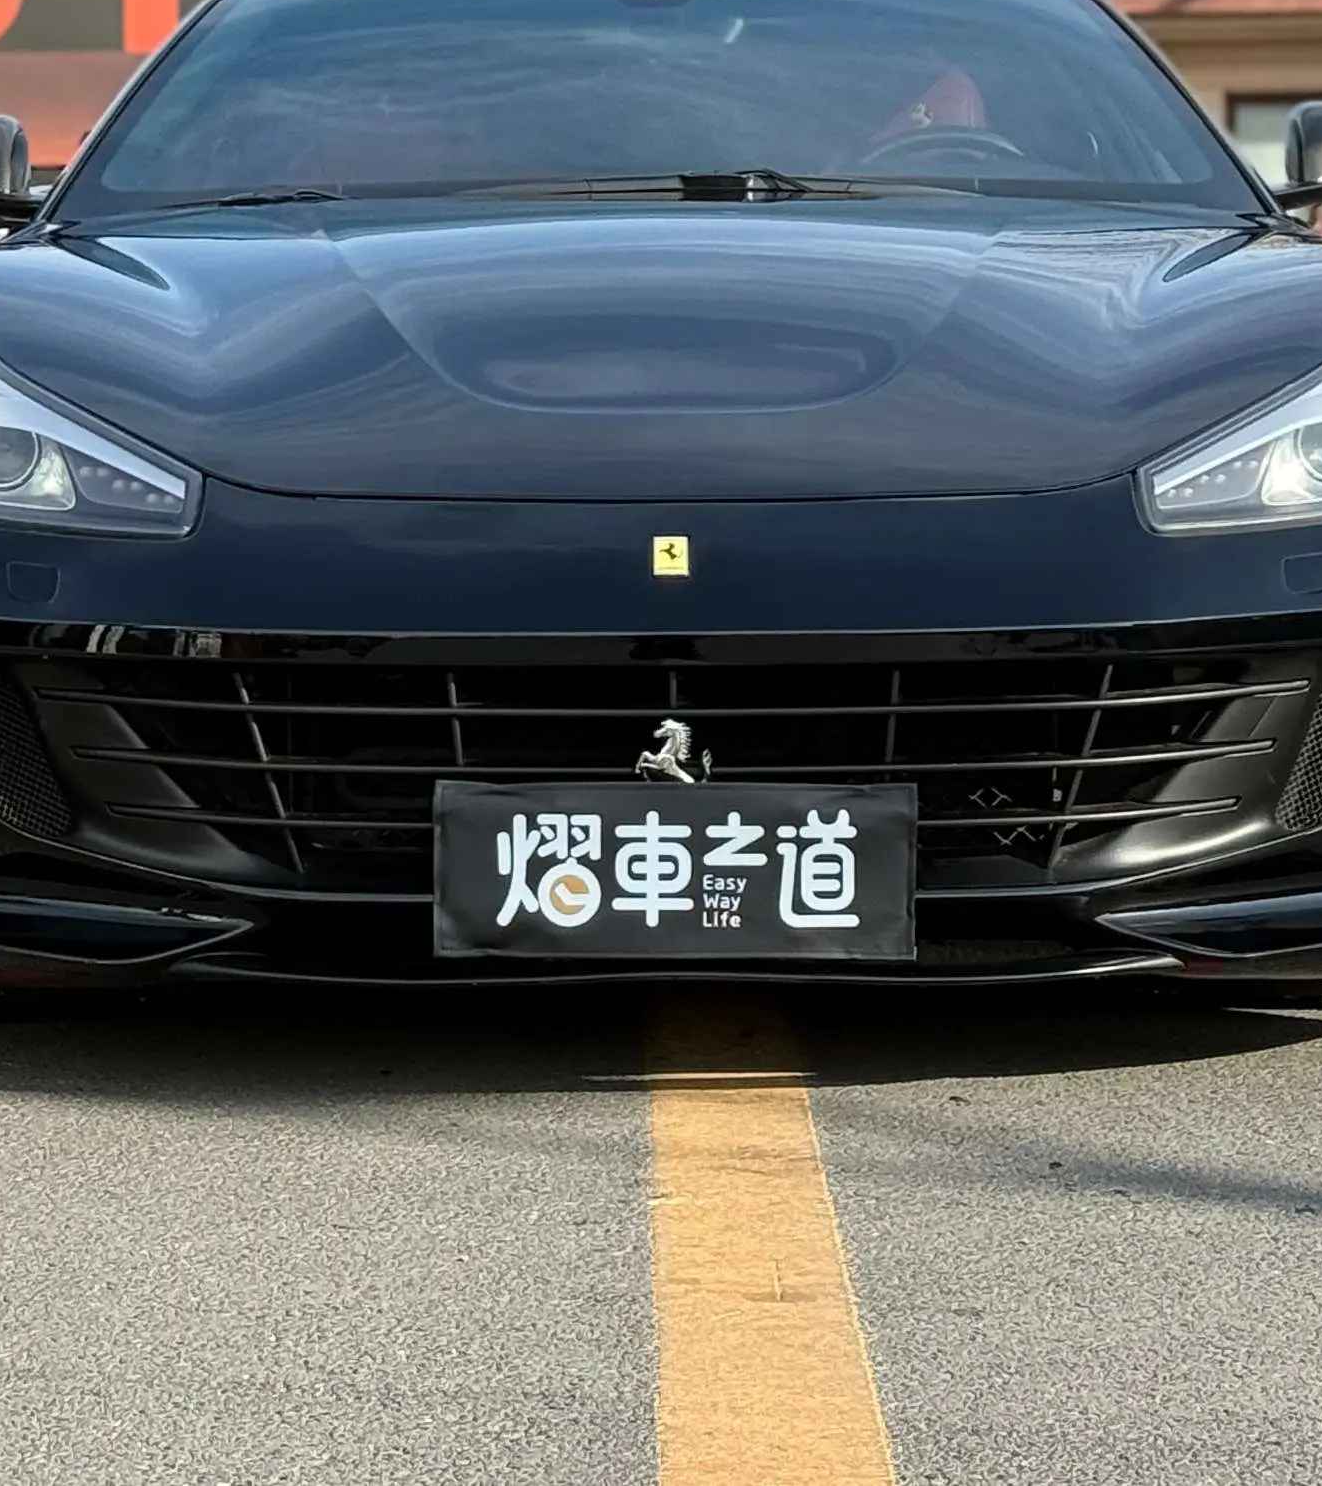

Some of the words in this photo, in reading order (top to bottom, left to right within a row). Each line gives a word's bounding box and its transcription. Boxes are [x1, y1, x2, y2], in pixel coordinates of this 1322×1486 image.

[496, 809, 860, 928] 熠車之道
[702, 874, 747, 893] Easy
[702, 893, 741, 911] Way
[702, 911, 742, 927] Life
